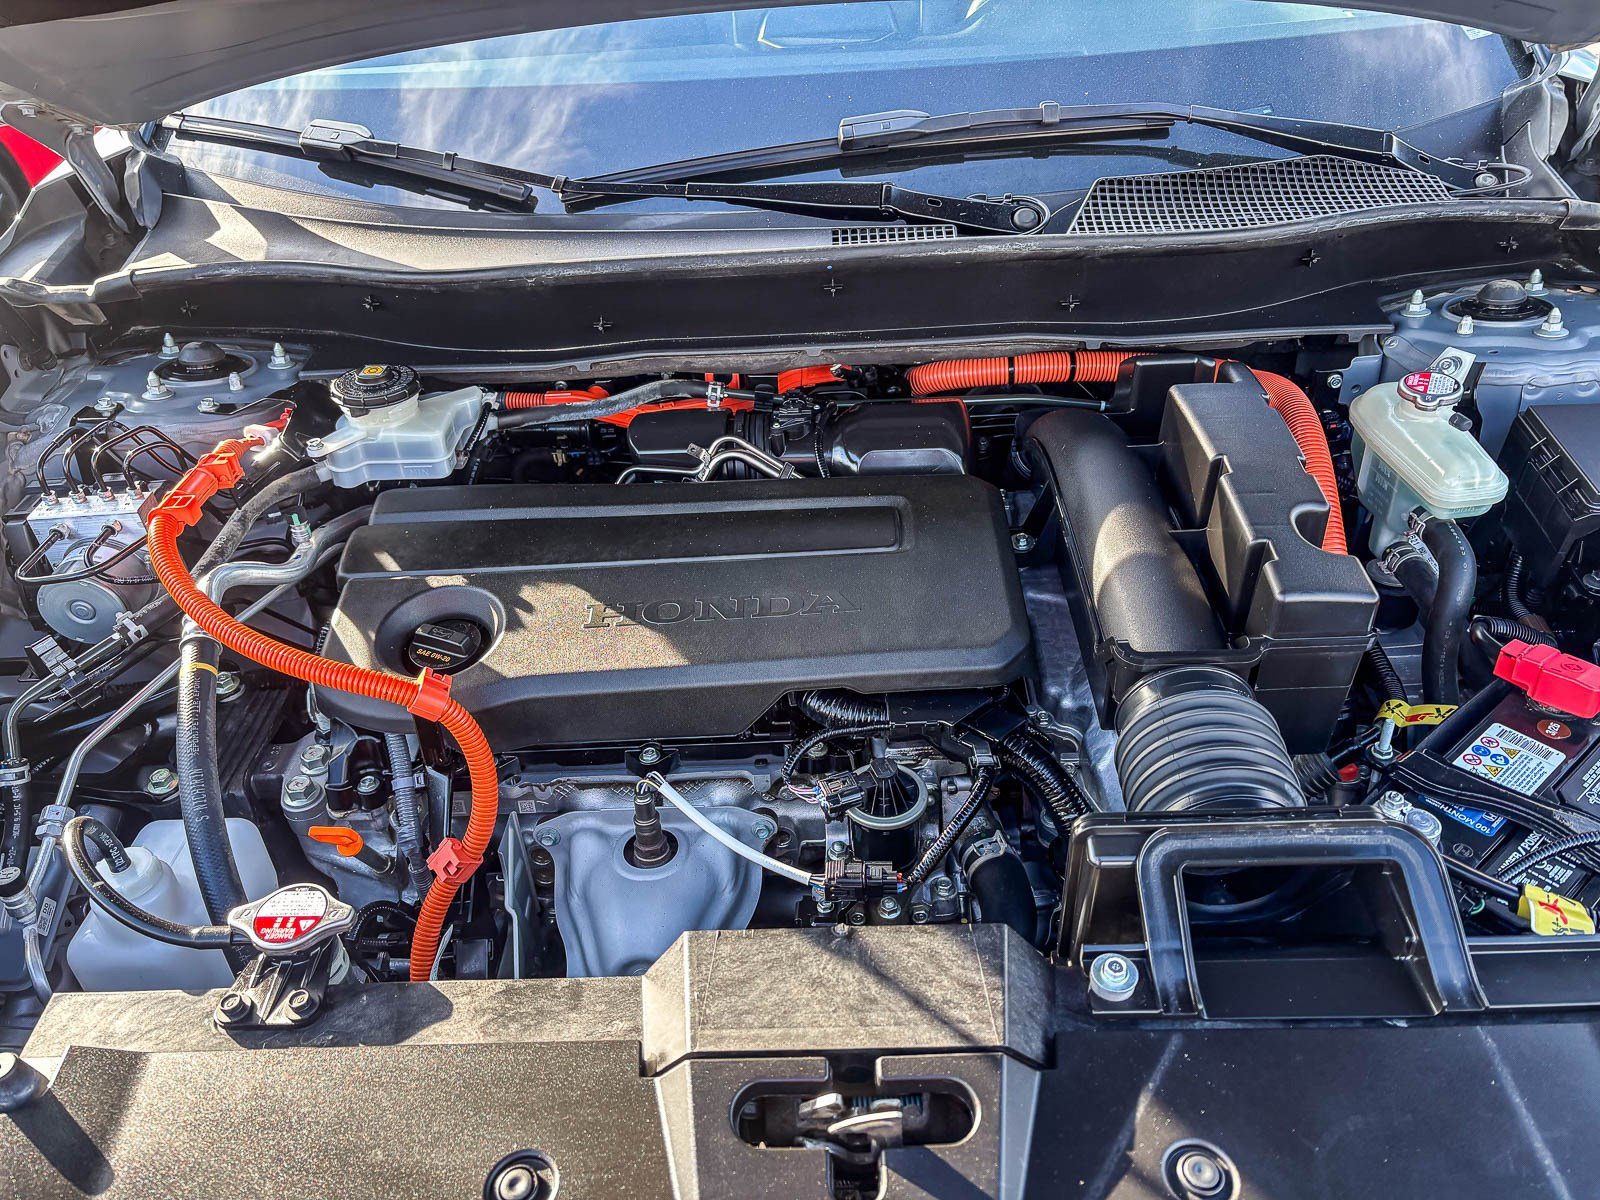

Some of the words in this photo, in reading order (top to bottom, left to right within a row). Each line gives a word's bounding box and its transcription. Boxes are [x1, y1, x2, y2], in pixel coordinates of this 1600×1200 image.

[582, 590, 861, 628] HONDA
[416, 648, 431, 657] SAE
[430, 652, 451, 662] 0W-20
[1440, 804, 1475, 825] MONTH
[1475, 823, 1491, 834] 100
